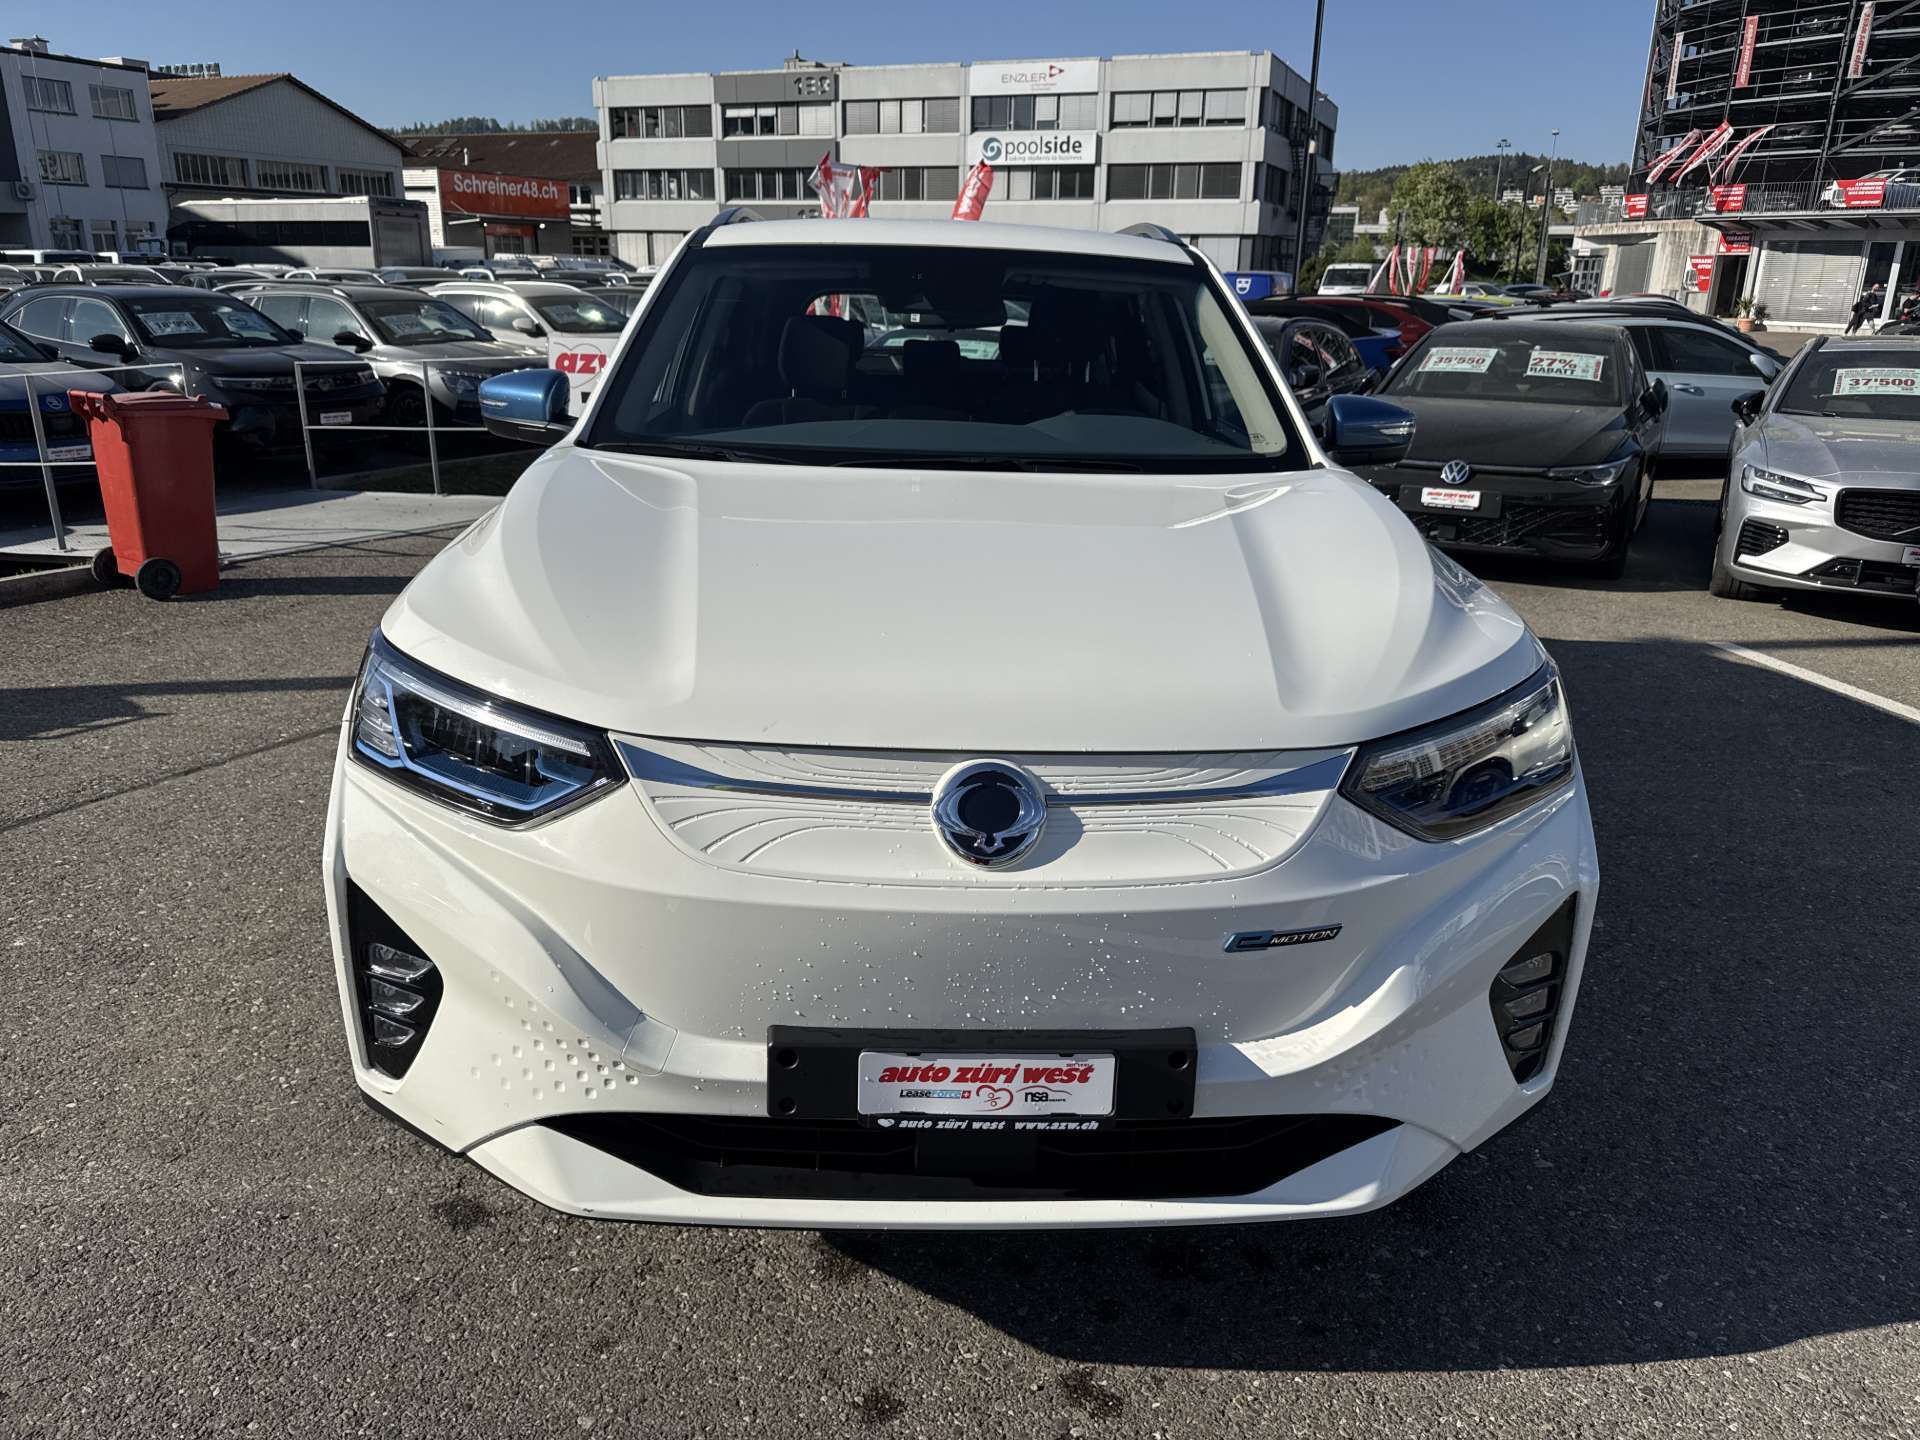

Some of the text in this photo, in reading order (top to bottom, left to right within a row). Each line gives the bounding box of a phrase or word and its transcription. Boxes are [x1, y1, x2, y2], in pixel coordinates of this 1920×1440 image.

[1001, 72, 1047, 84] ENZLER
[1005, 135, 1082, 161] poolside
[453, 174, 558, 199] Schreiner48.ch
[1531, 357, 1577, 369] 27%
[1529, 366, 1576, 375] RABATT
[1848, 378, 1916, 387] 37'500
[878, 1063, 1095, 1084] auto züri west
[1024, 1090, 1048, 1103] nsa
[898, 1118, 1099, 1130] auto züri west www.azw.ch
